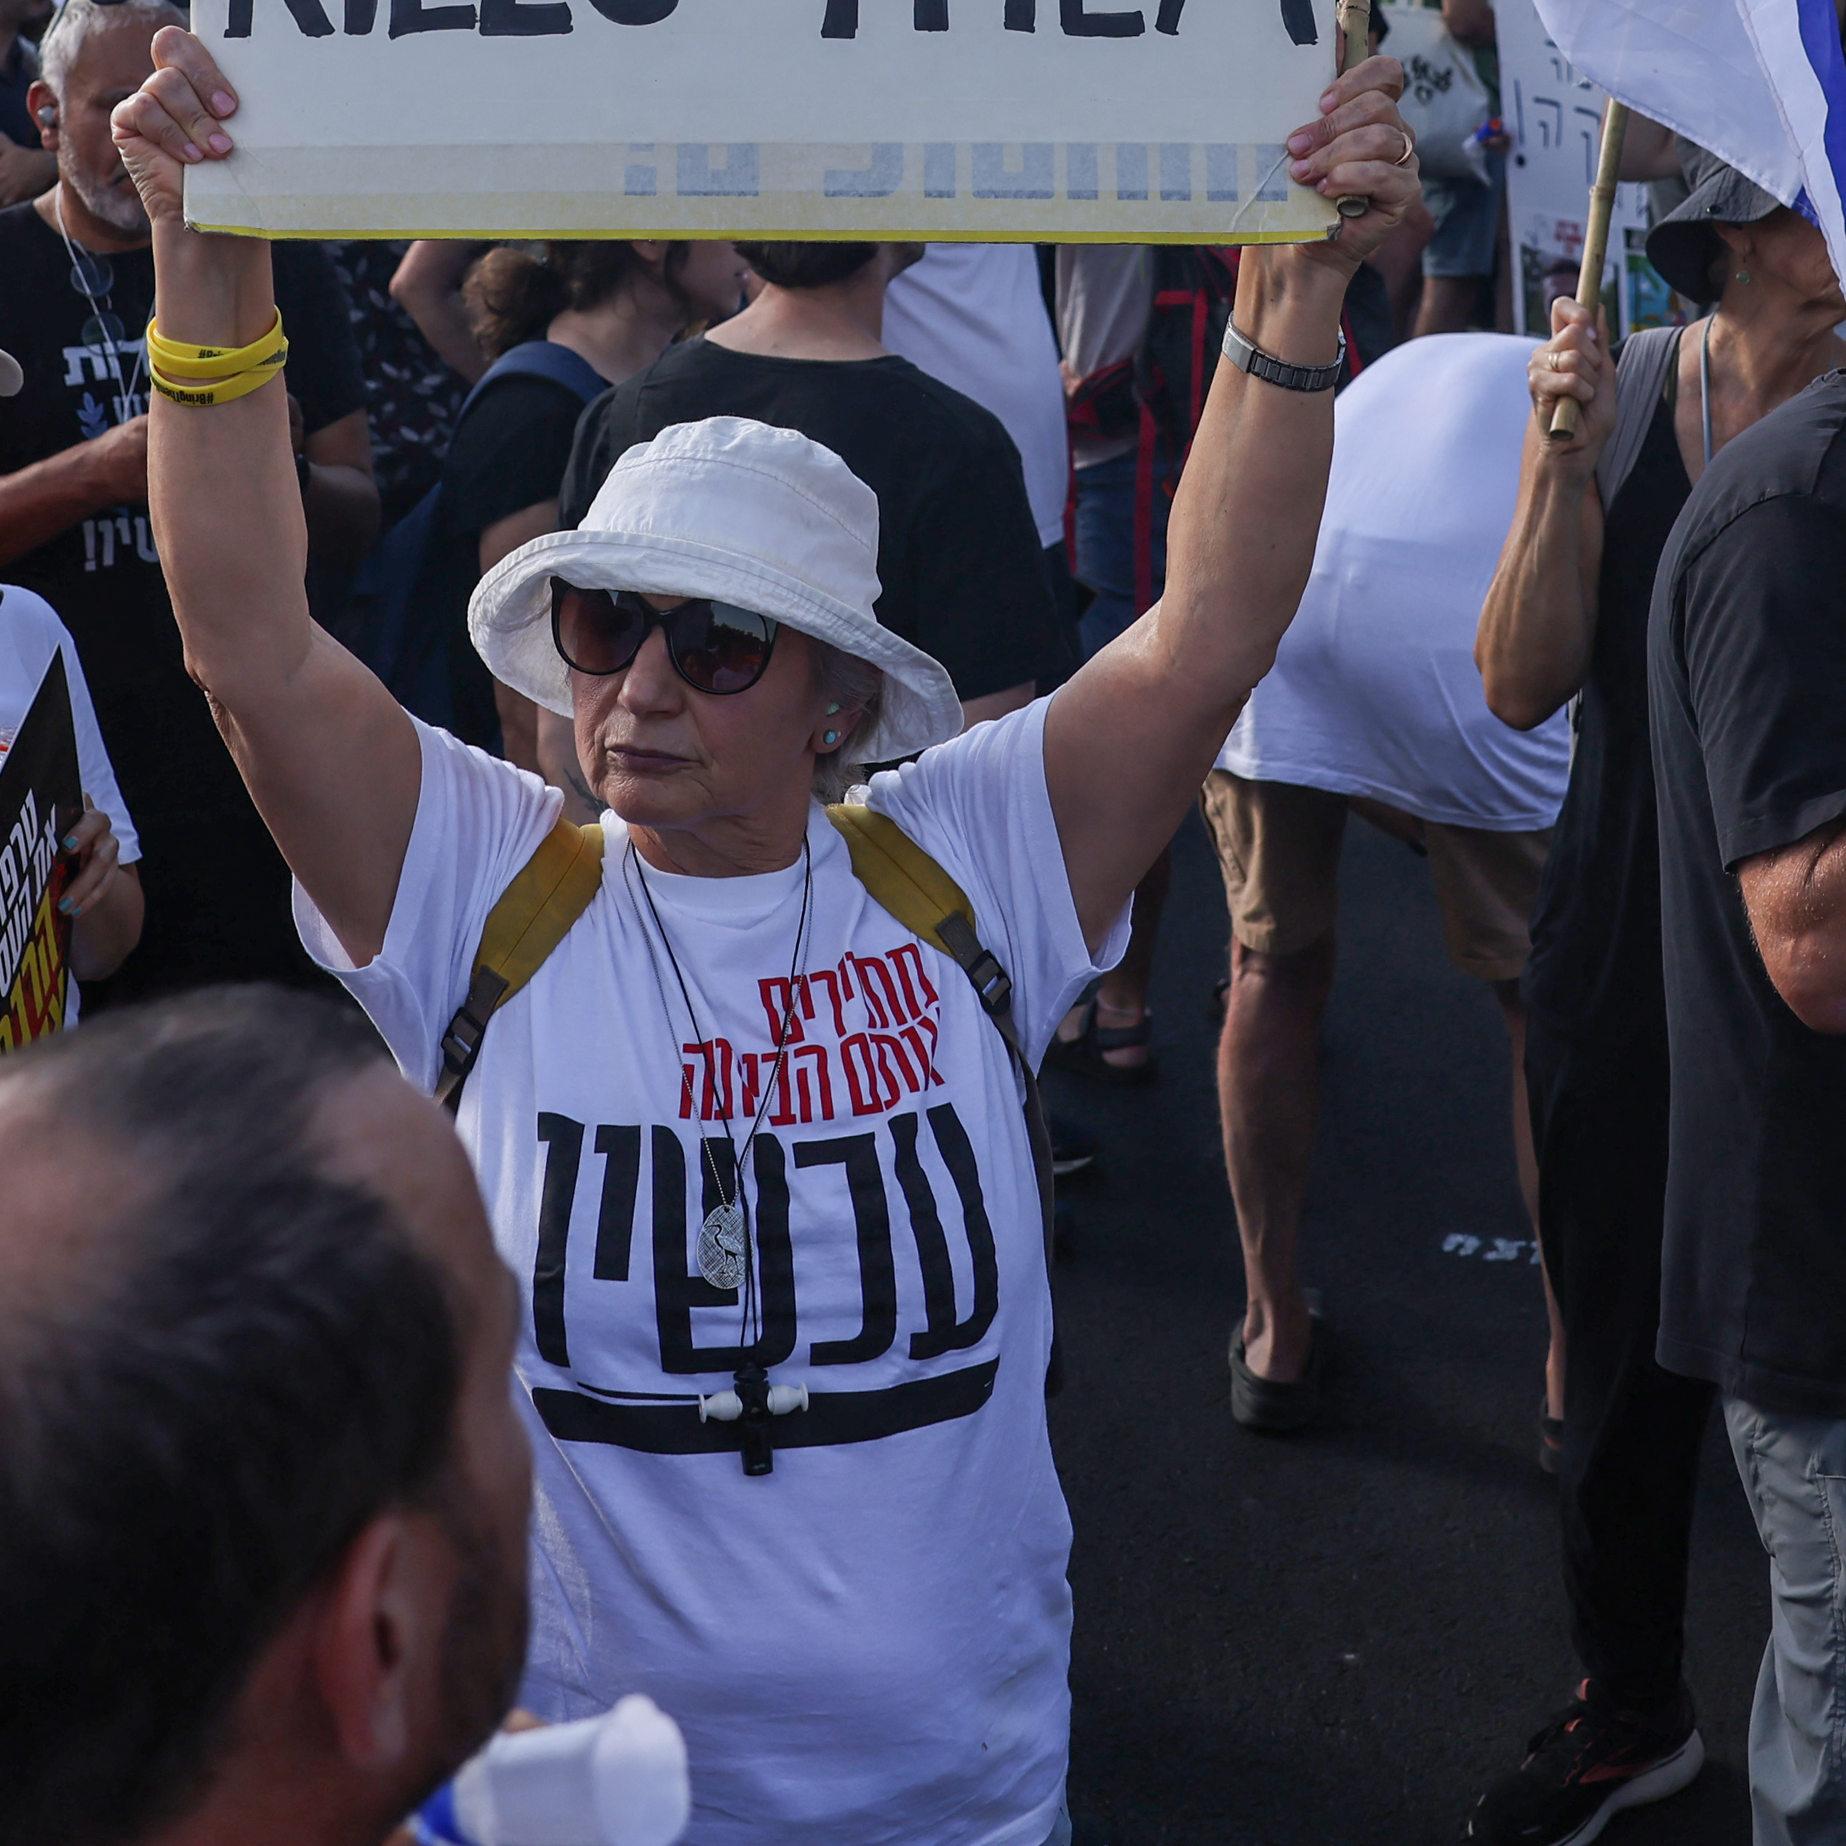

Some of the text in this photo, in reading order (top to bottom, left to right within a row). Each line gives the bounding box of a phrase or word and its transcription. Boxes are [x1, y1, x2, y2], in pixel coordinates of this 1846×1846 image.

[33, 803, 59, 905] את
[677, 1006, 945, 1127] אותם הביתה
[532, 1102, 999, 1375] עכשיו
